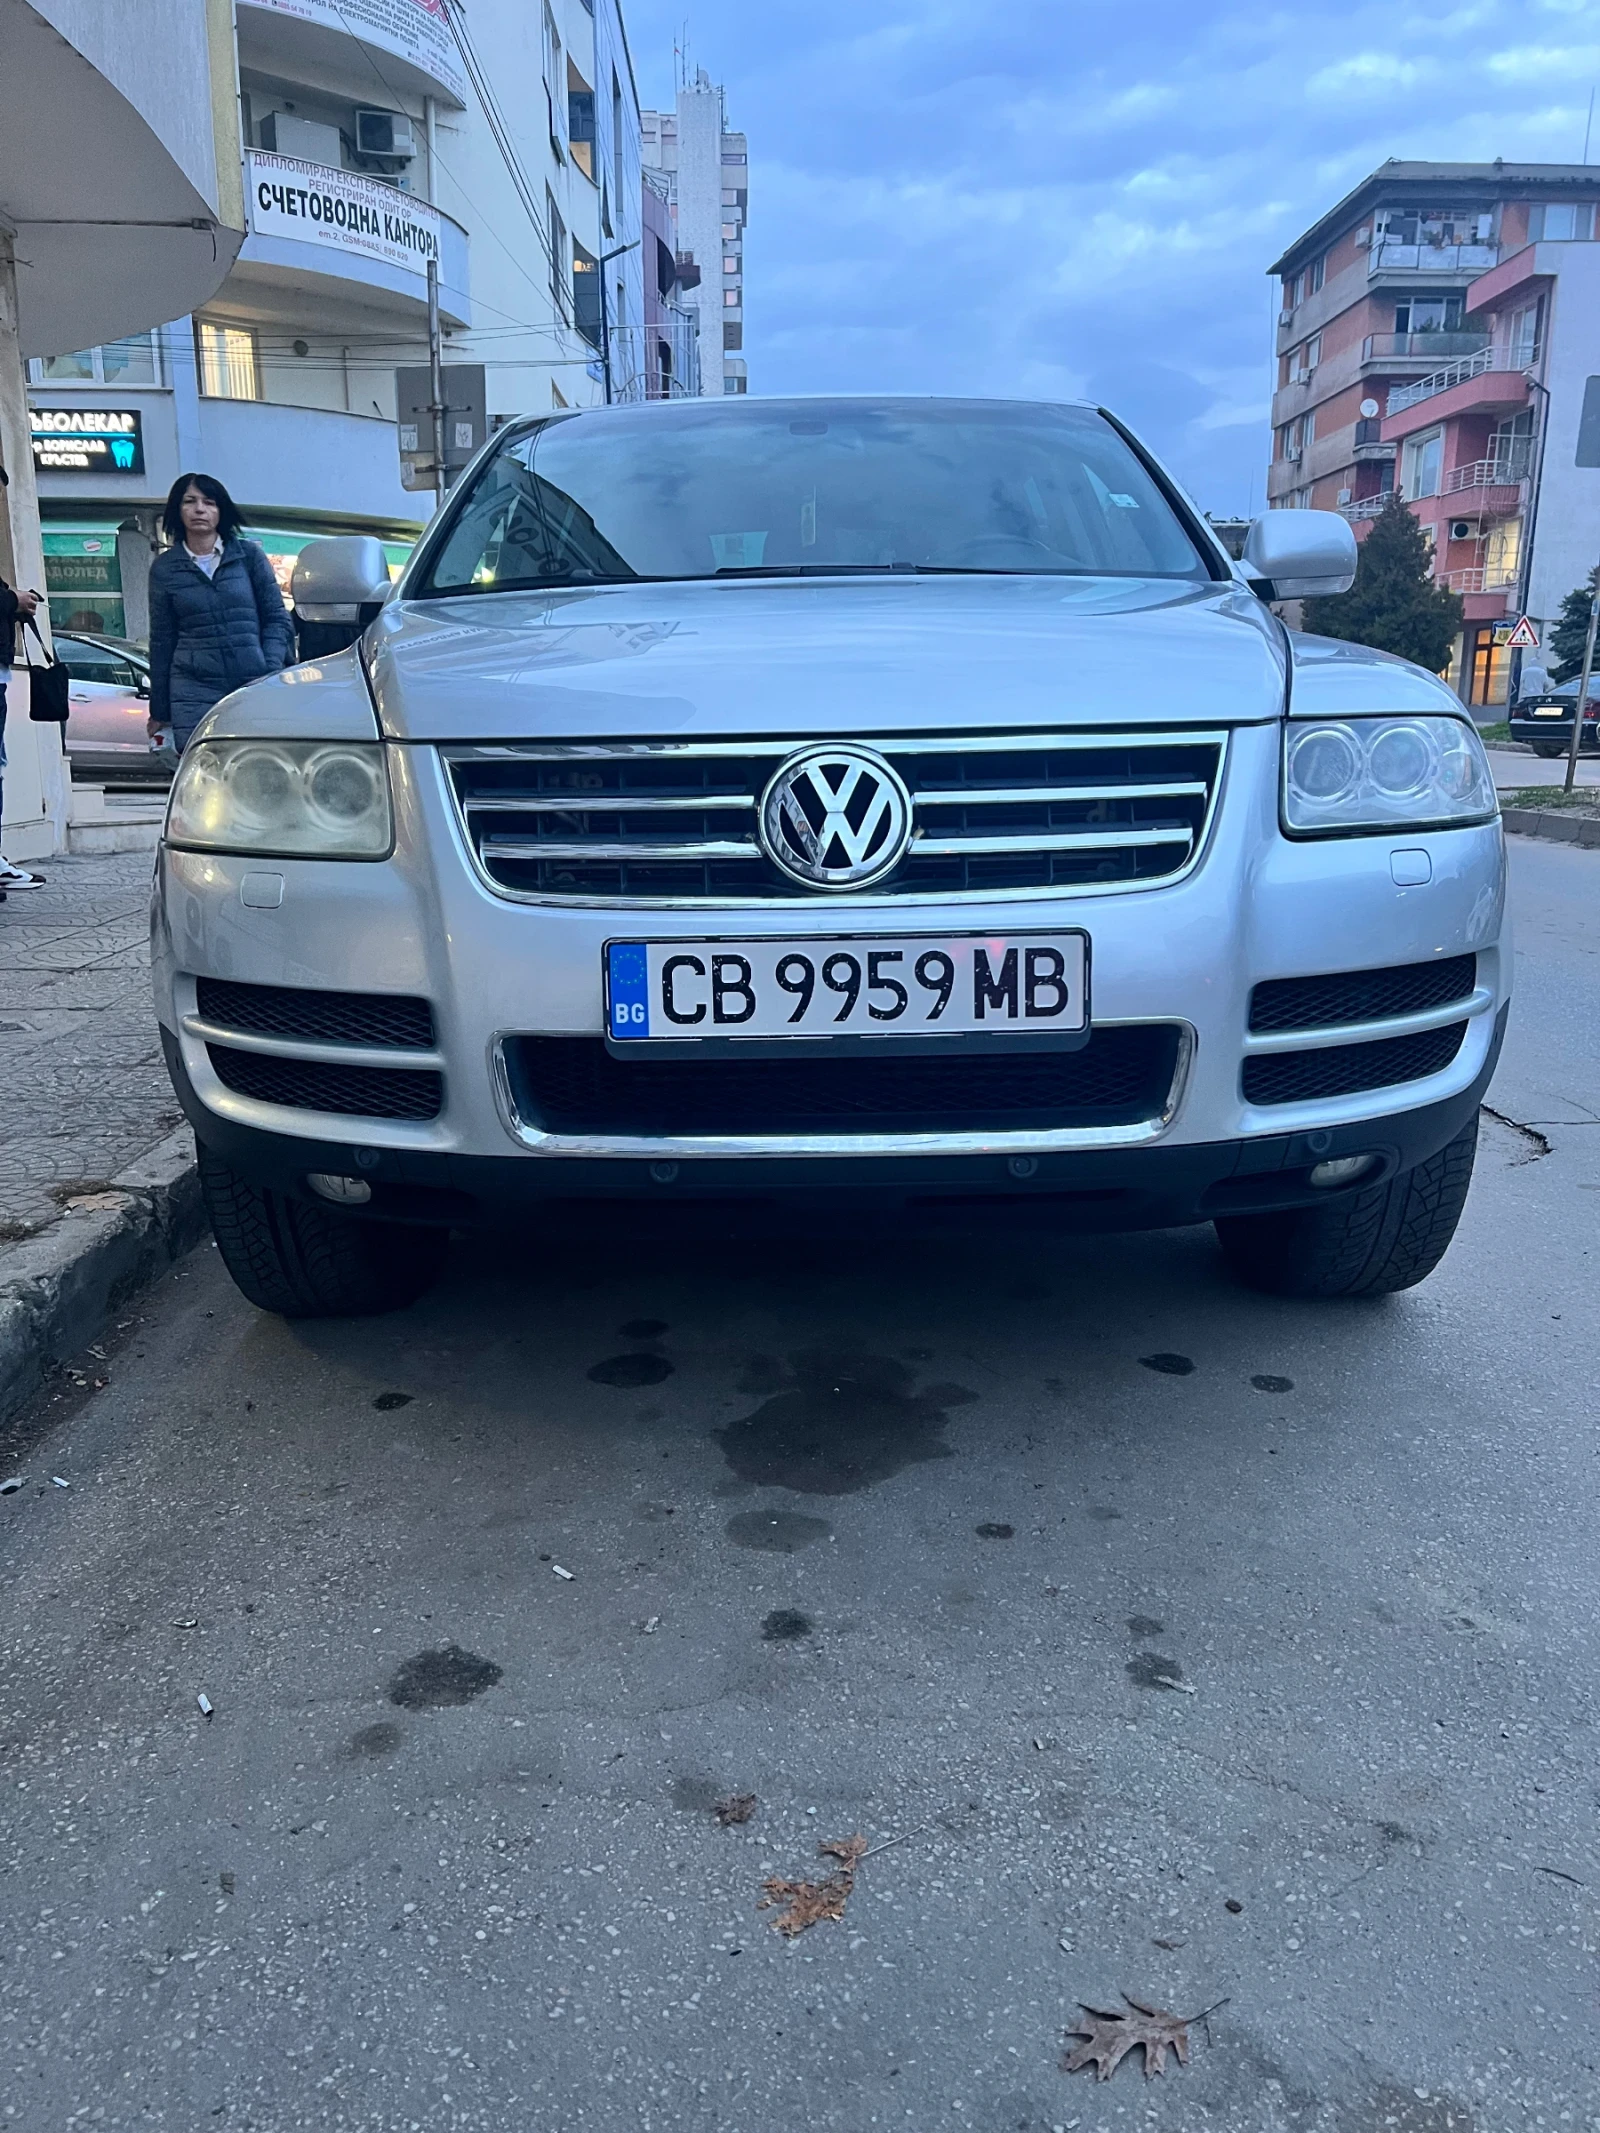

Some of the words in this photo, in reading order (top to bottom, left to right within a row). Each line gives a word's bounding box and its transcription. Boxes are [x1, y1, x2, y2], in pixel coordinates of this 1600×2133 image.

[254, 153, 334, 182] ДИПЛОМИРАН
[308, 178, 377, 208] РЕГИСТРИРАН
[258, 182, 381, 238] СЧЕТОВОДНА
[384, 213, 440, 262] КАНТОРА
[40, 453, 89, 466] КРЪСТЕВ
[43, 439, 107, 453] БОРИСЛАВ
[775, 950, 955, 1023] 9959
[973, 946, 1069, 1020] MB
[615, 1003, 645, 1024] BG
